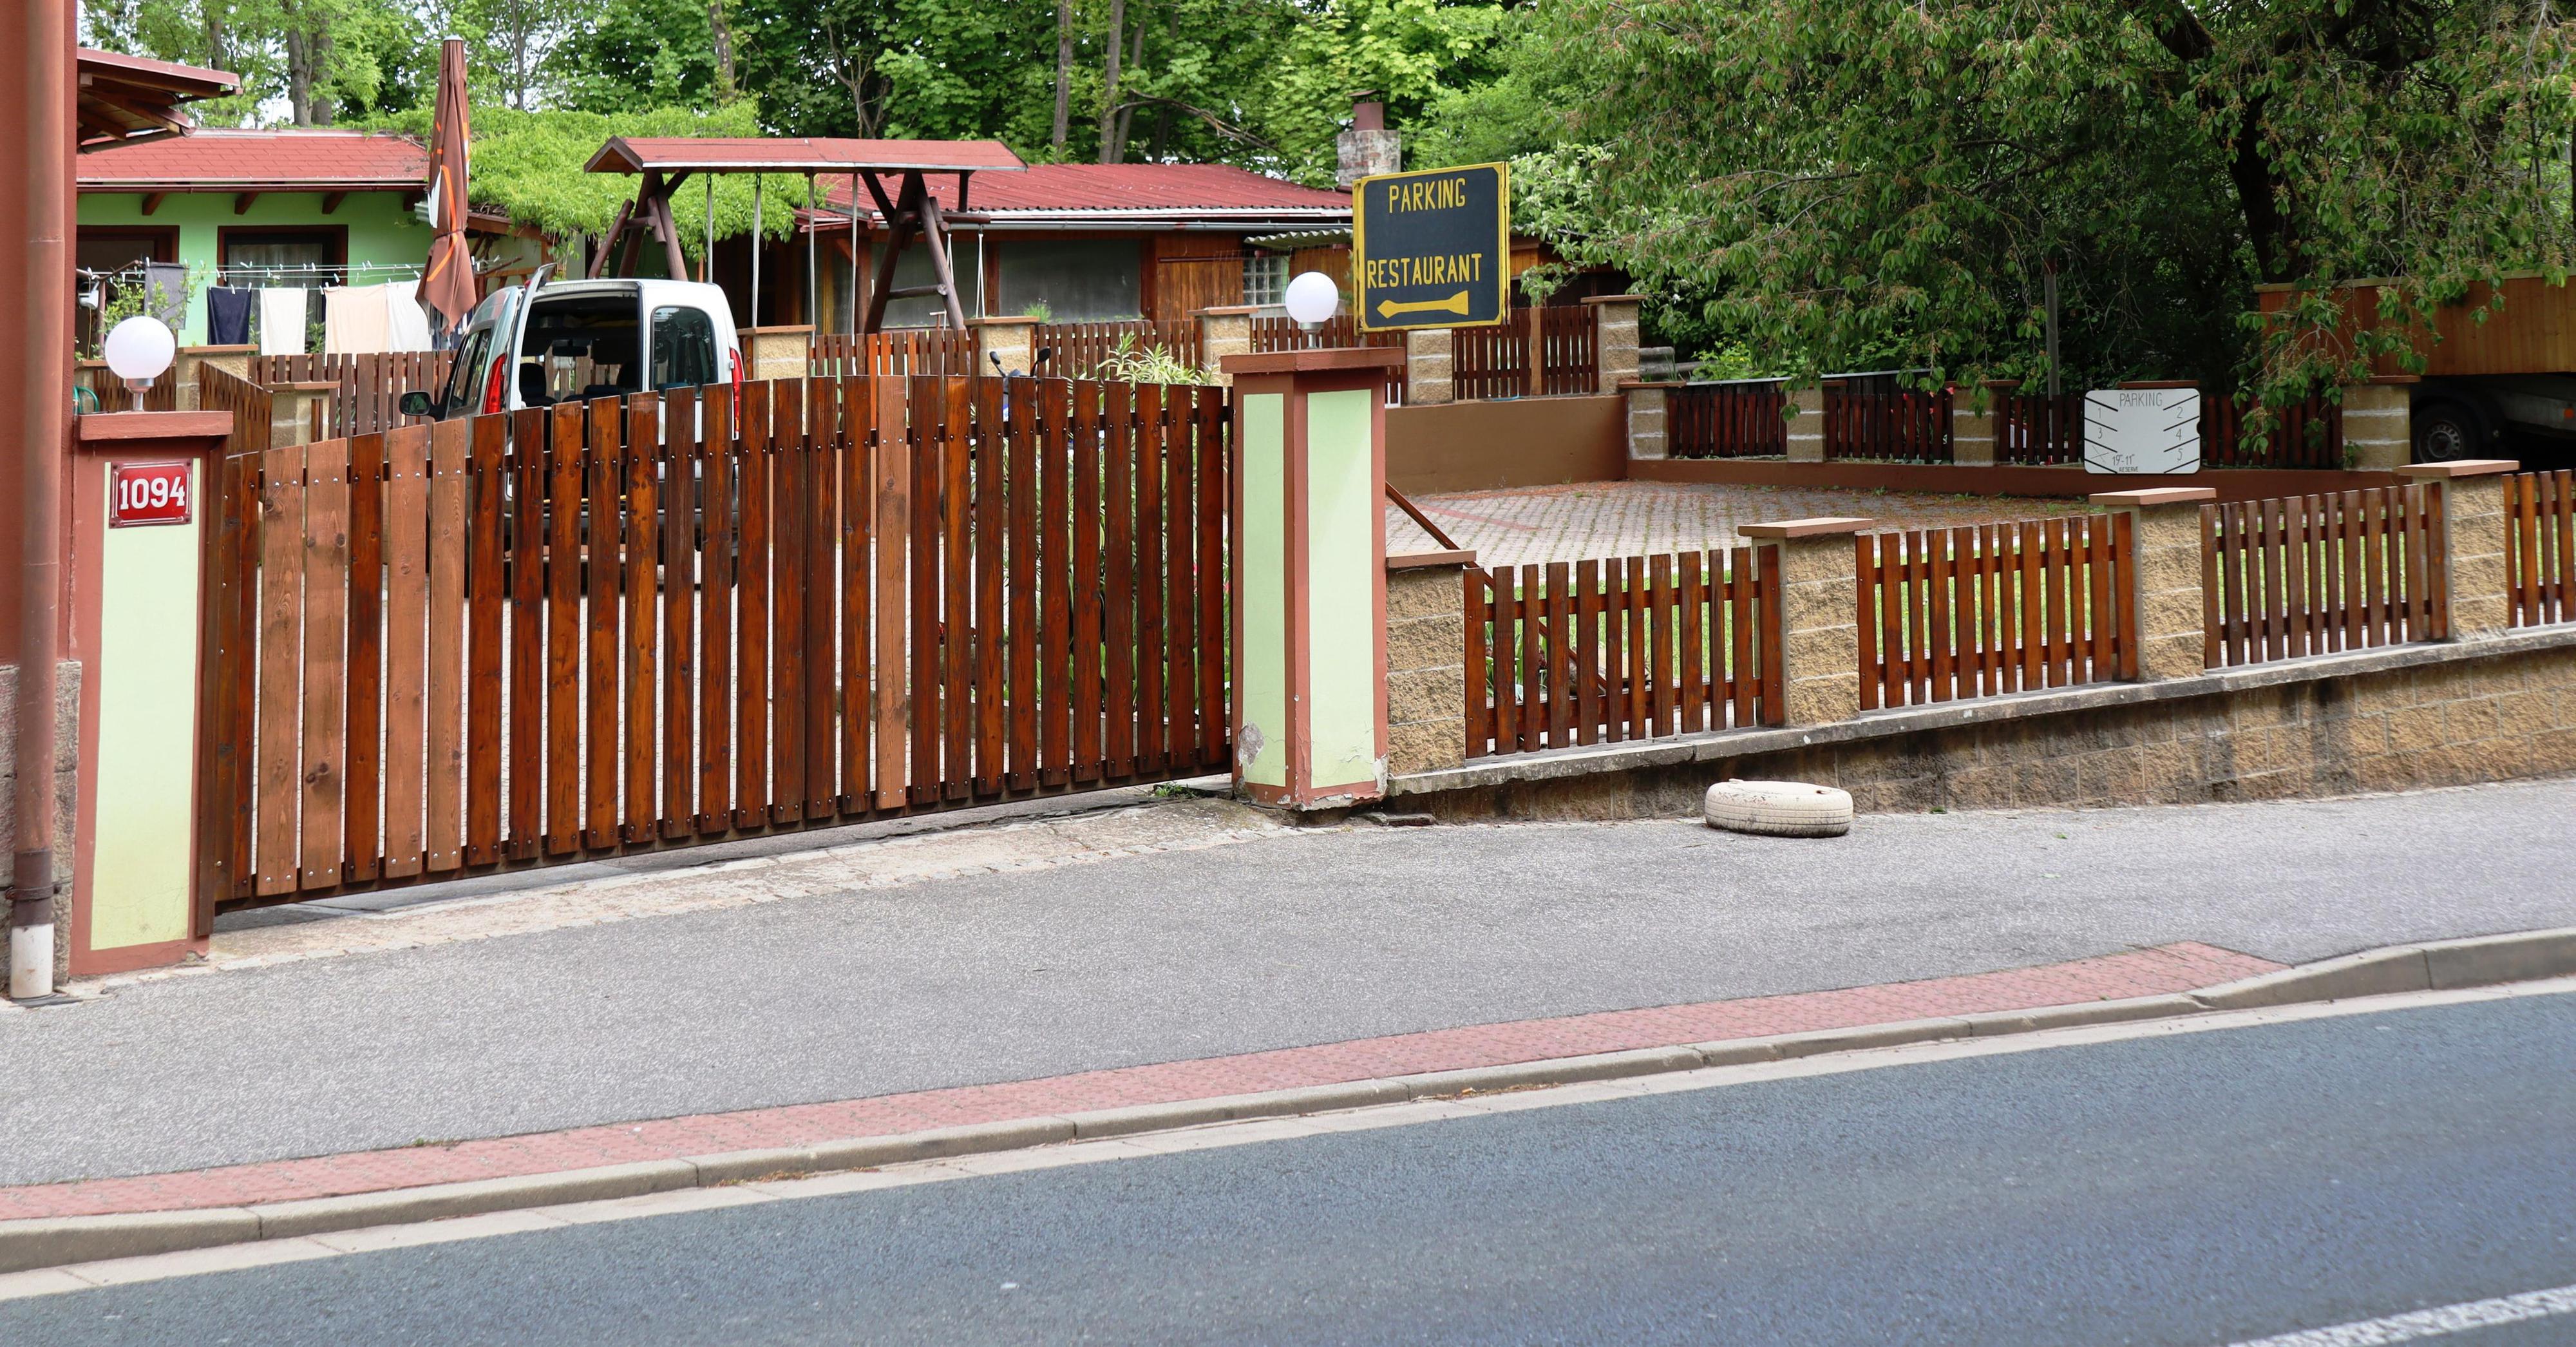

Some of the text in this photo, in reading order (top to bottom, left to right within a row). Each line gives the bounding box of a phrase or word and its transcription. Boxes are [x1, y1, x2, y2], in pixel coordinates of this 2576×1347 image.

[1388, 178, 1466, 213] PARKING
[1367, 253, 1482, 289] RESTAURANT
[2119, 392, 2163, 407] PARKING
[2098, 406, 2101, 419] 1
[2176, 406, 2183, 419] 2
[2098, 427, 2103, 439] 3
[2175, 428, 2182, 441] 4
[2177, 448, 2183, 461] 5
[120, 477, 185, 510] 1094
